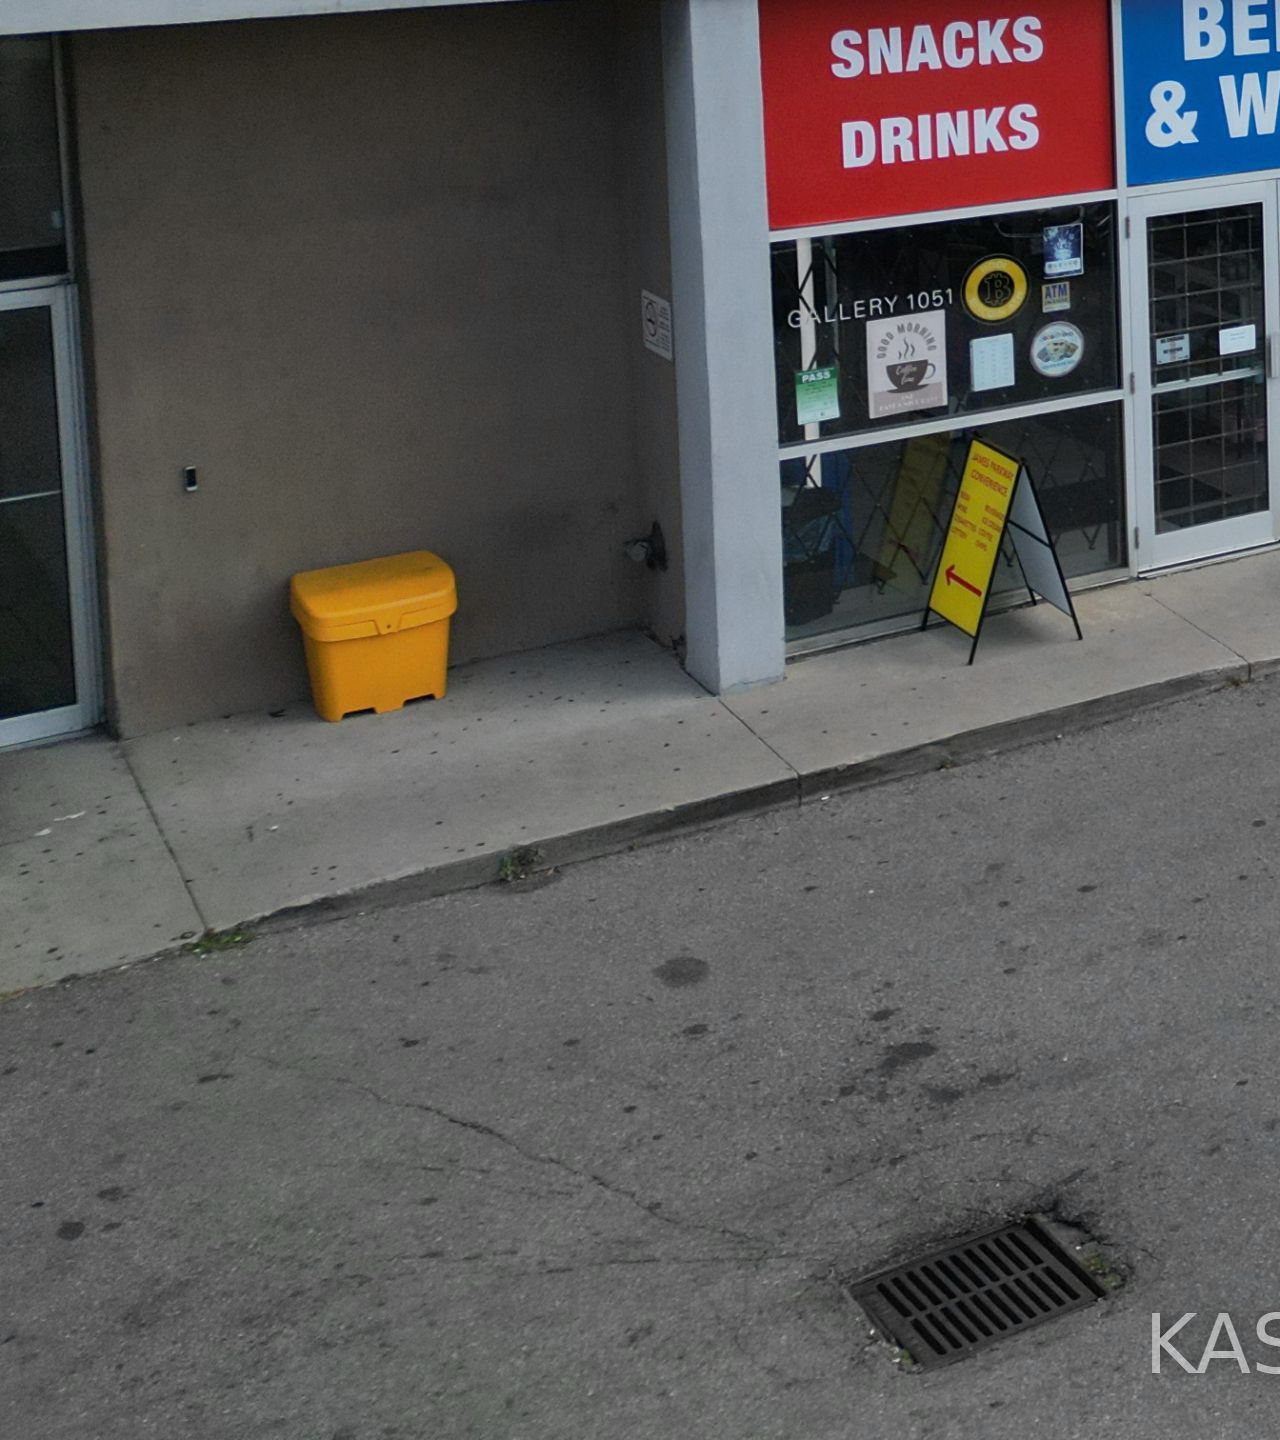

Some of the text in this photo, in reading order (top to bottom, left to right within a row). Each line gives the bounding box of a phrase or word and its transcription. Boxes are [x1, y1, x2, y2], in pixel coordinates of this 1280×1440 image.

[830, 16, 1044, 78] SNACKS
[841, 103, 1040, 169] DRINKS
[1144, 80, 1199, 148] &
[787, 288, 954, 328] GALLERY 1051
[1044, 283, 1069, 301] ATM
[801, 371, 831, 384] PASS
